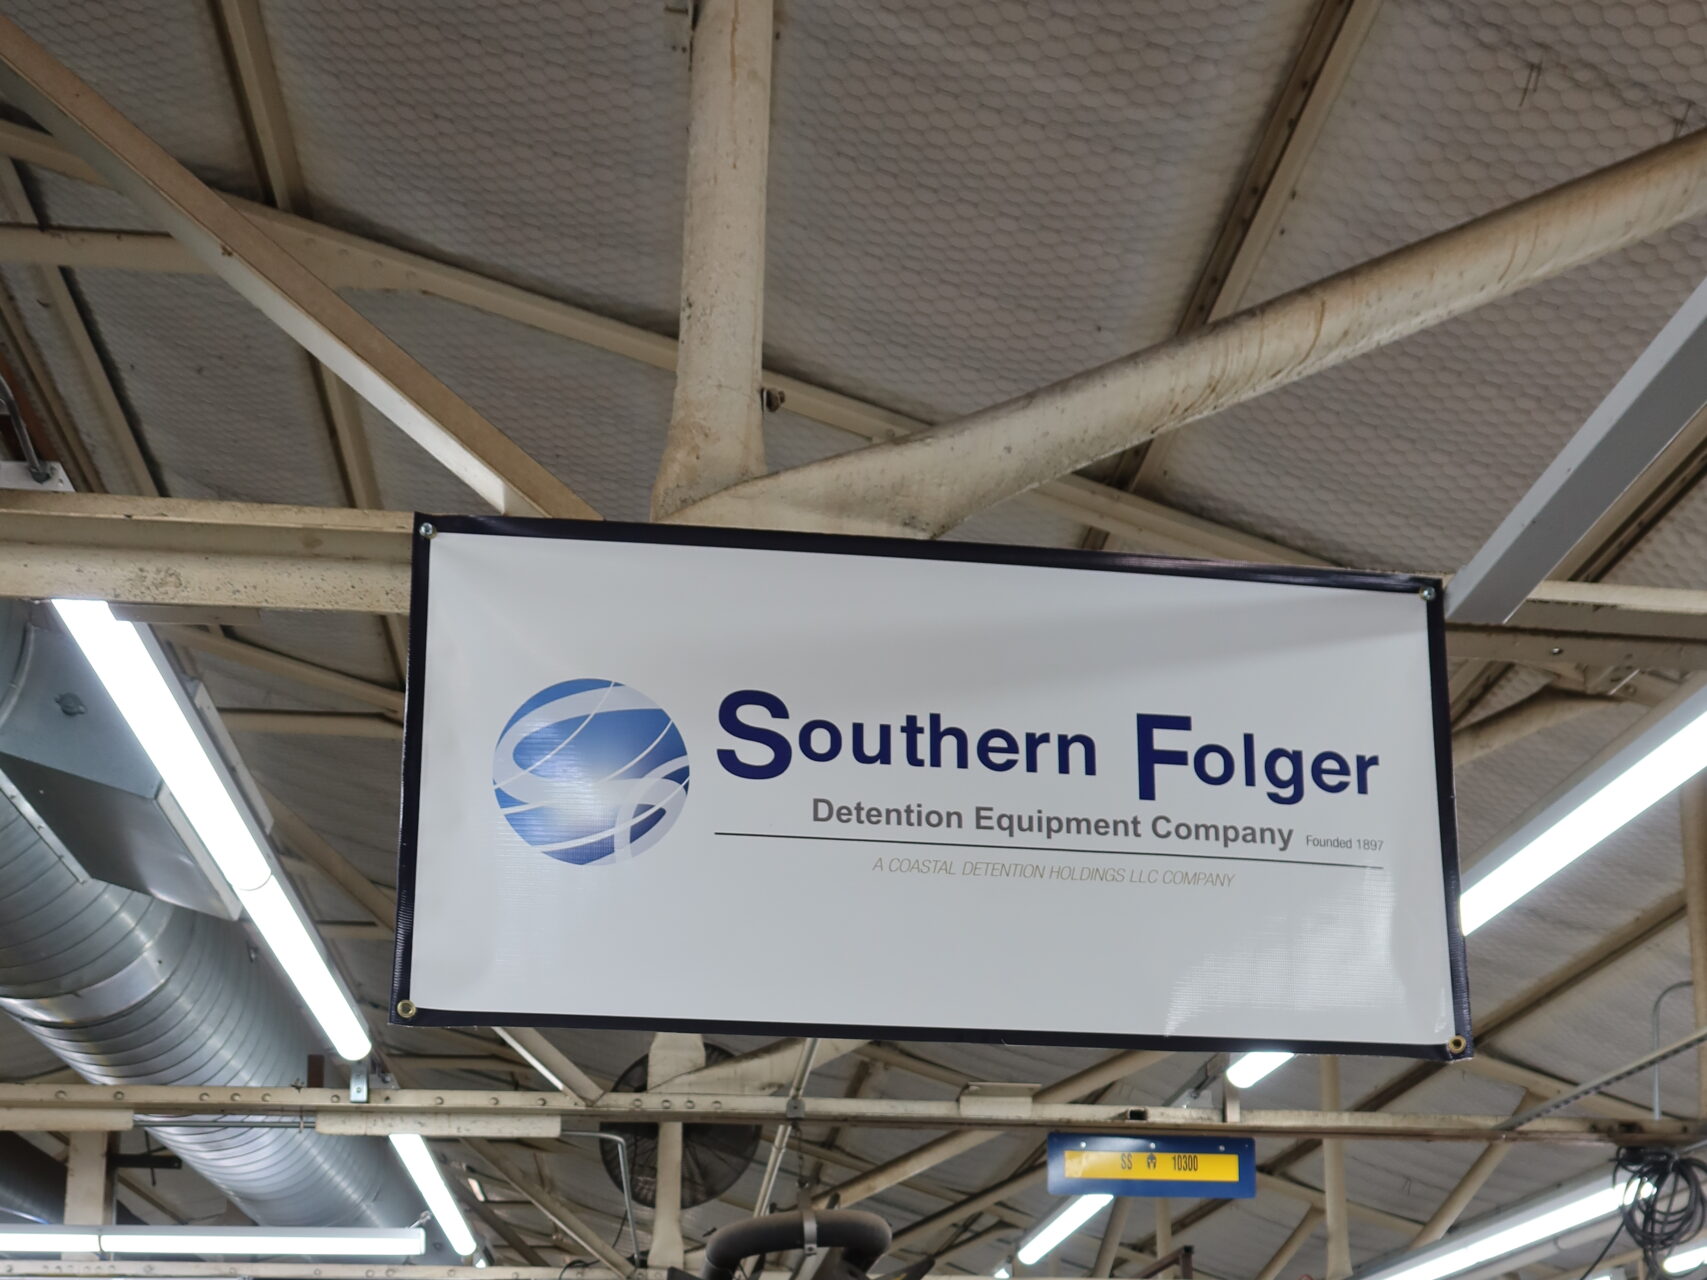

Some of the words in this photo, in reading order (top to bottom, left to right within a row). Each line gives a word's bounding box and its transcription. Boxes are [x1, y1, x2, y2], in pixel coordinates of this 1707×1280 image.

[716, 689, 1097, 780] Southern
[1136, 712, 1380, 805] Folger
[812, 797, 964, 829] Detention
[975, 805, 1142, 840] Equipment
[1151, 814, 1295, 852] Company
[1306, 834, 1352, 849] Founded
[1356, 838, 1384, 852] 1897
[872, 856, 885, 872] A
[888, 857, 956, 875] COASTAL
[961, 860, 1046, 880] DETENTION
[1049, 864, 1126, 883] HOLDINGS
[1129, 868, 1159, 884] LLC
[1161, 870, 1236, 888] COMPANY
[1120, 1152, 1133, 1170] SS
[1172, 1154, 1199, 1172] 10300
